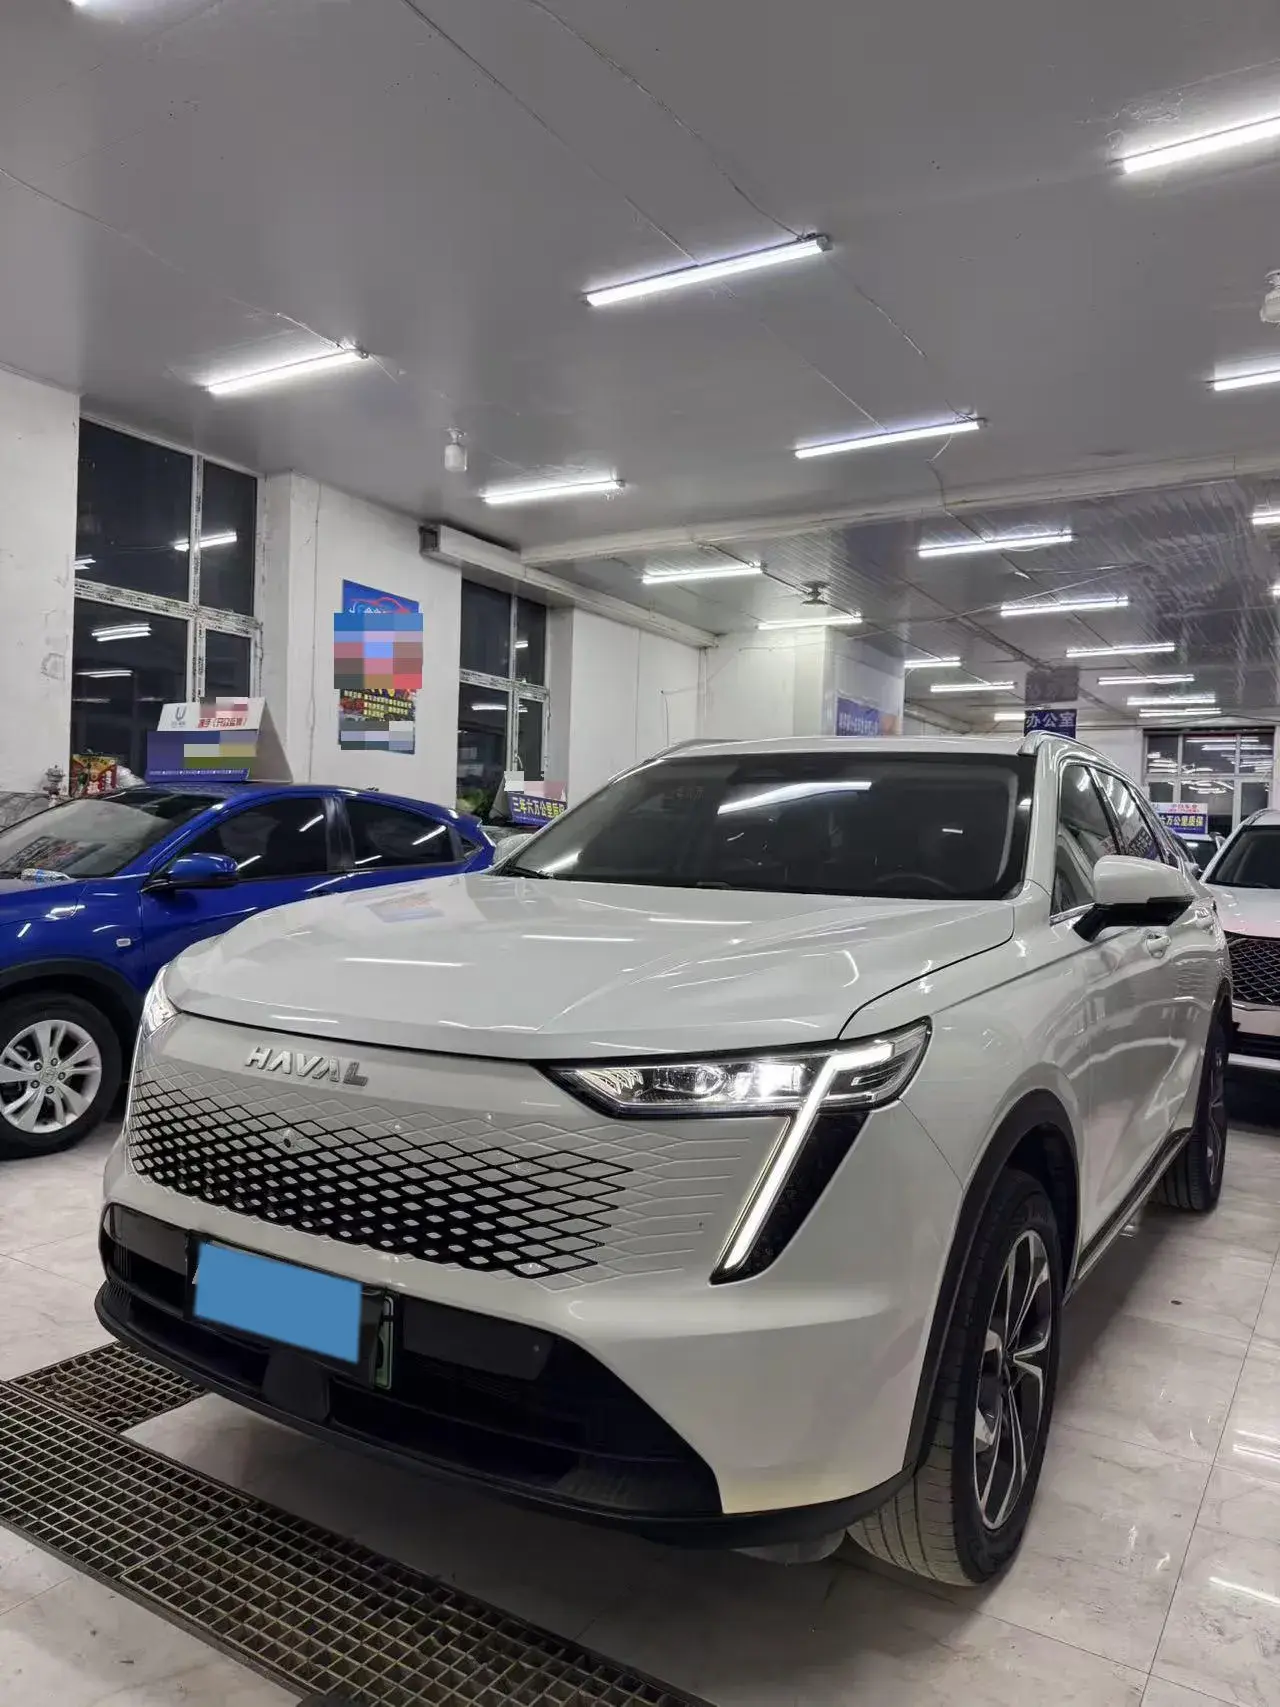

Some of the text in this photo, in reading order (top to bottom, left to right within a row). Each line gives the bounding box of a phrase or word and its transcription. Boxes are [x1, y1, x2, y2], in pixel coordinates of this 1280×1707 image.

[1026, 712, 1075, 728] 办公室
[245, 1047, 368, 1086] HAVAL
